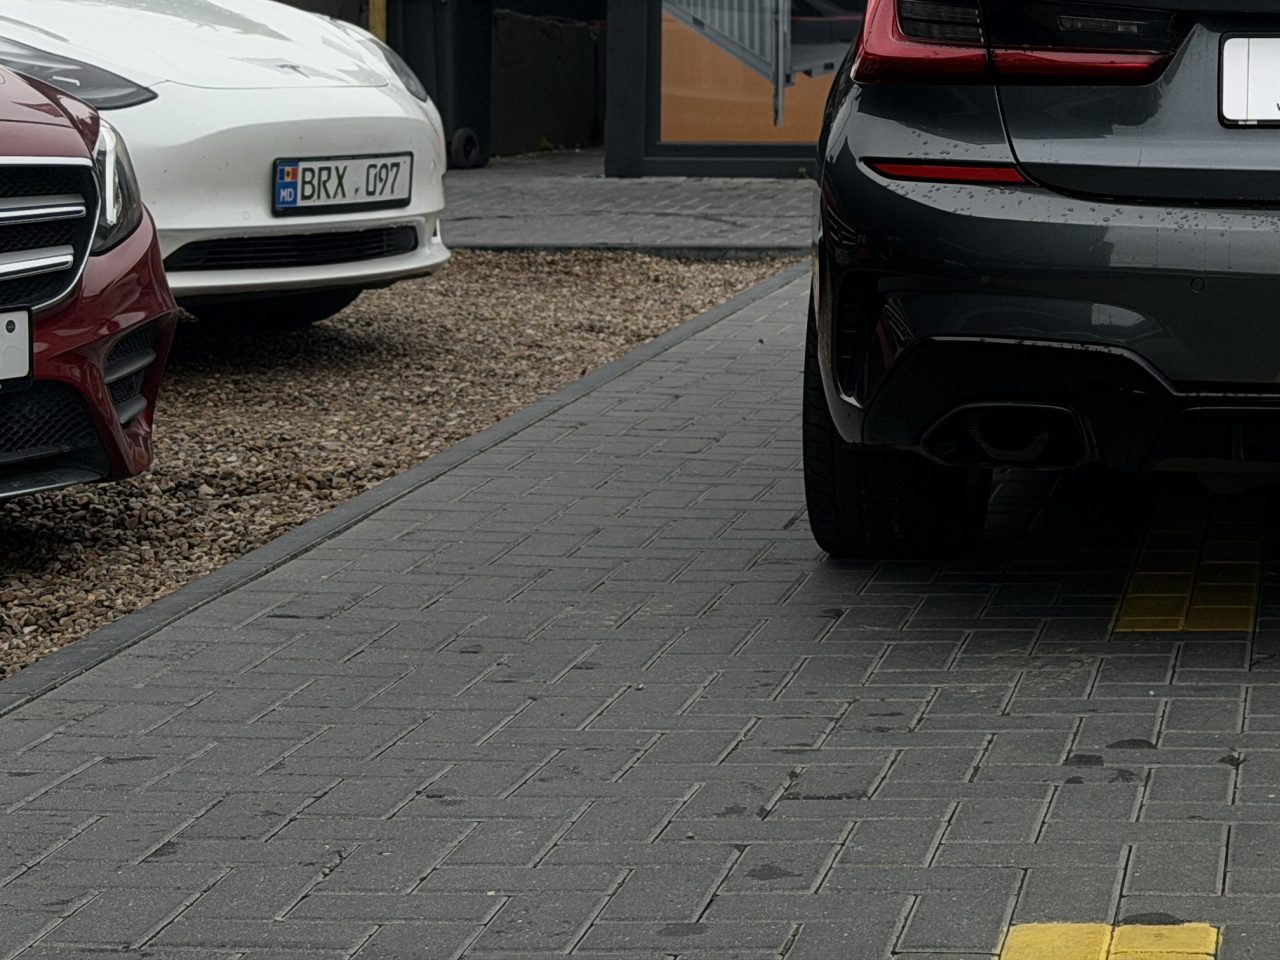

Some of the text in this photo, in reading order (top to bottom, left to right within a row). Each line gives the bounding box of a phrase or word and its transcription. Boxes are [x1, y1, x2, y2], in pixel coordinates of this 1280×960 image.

[301, 162, 401, 200] BRX 097
[279, 188, 295, 202] MD
